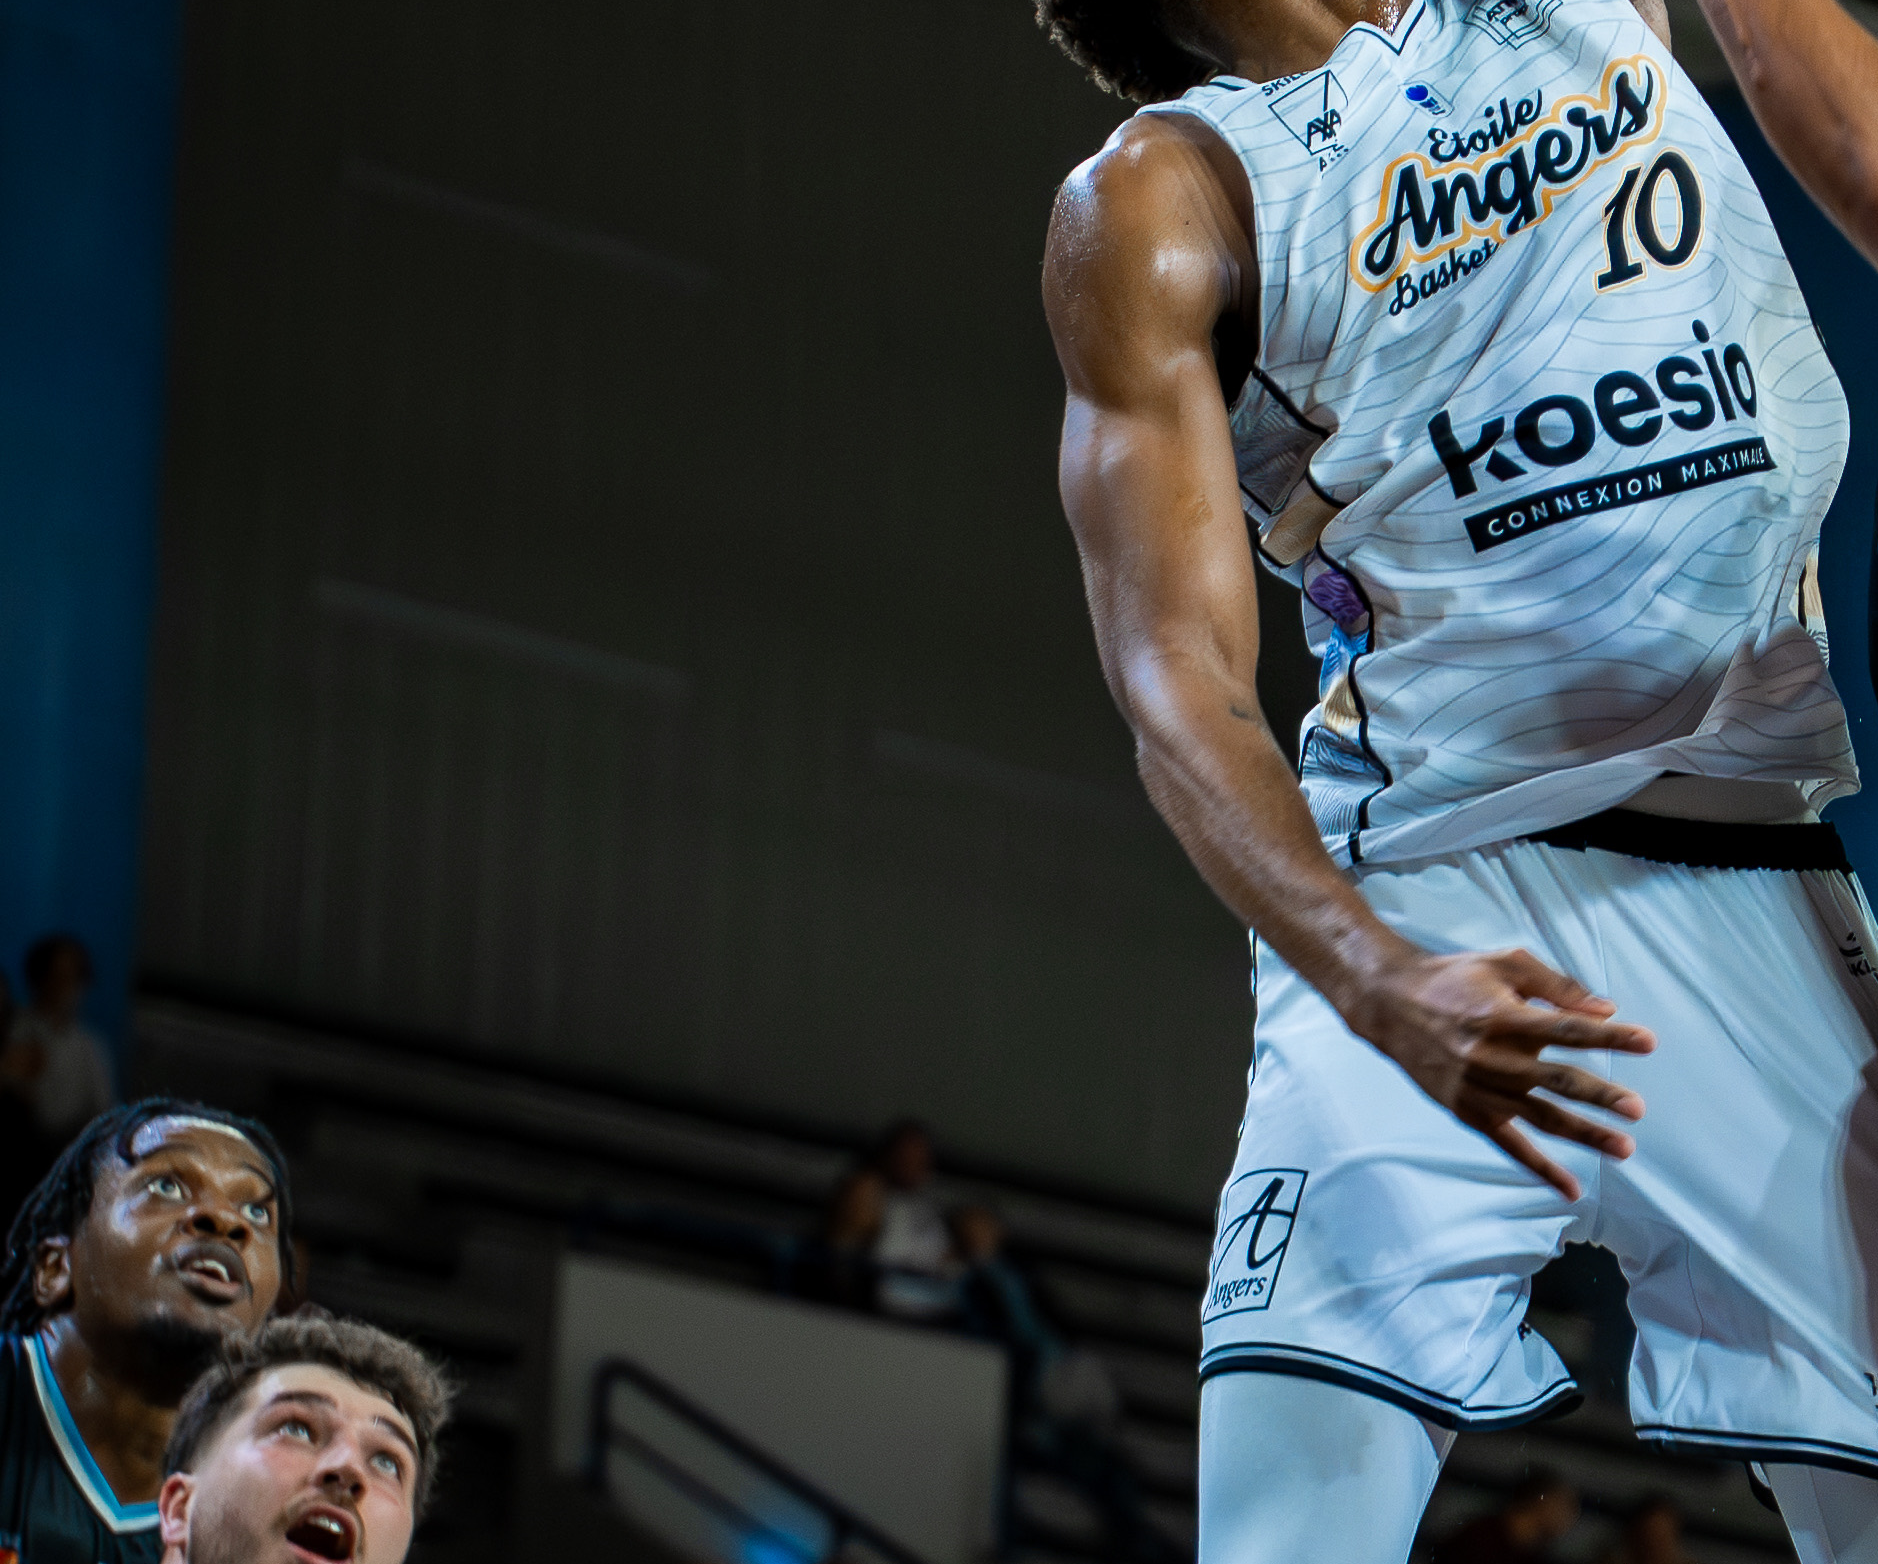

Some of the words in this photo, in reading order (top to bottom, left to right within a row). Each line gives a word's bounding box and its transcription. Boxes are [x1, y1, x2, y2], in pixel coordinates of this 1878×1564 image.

[1363, 63, 1656, 277] Angers
[1597, 150, 1702, 291] 10
[1388, 241, 1500, 316] Basket
[1428, 319, 1757, 499] koesio
[1487, 473, 1663, 537] CONNEXION
[1681, 446, 1766, 483] MAXIMALE
[1211, 1276, 1268, 1310] Angers
